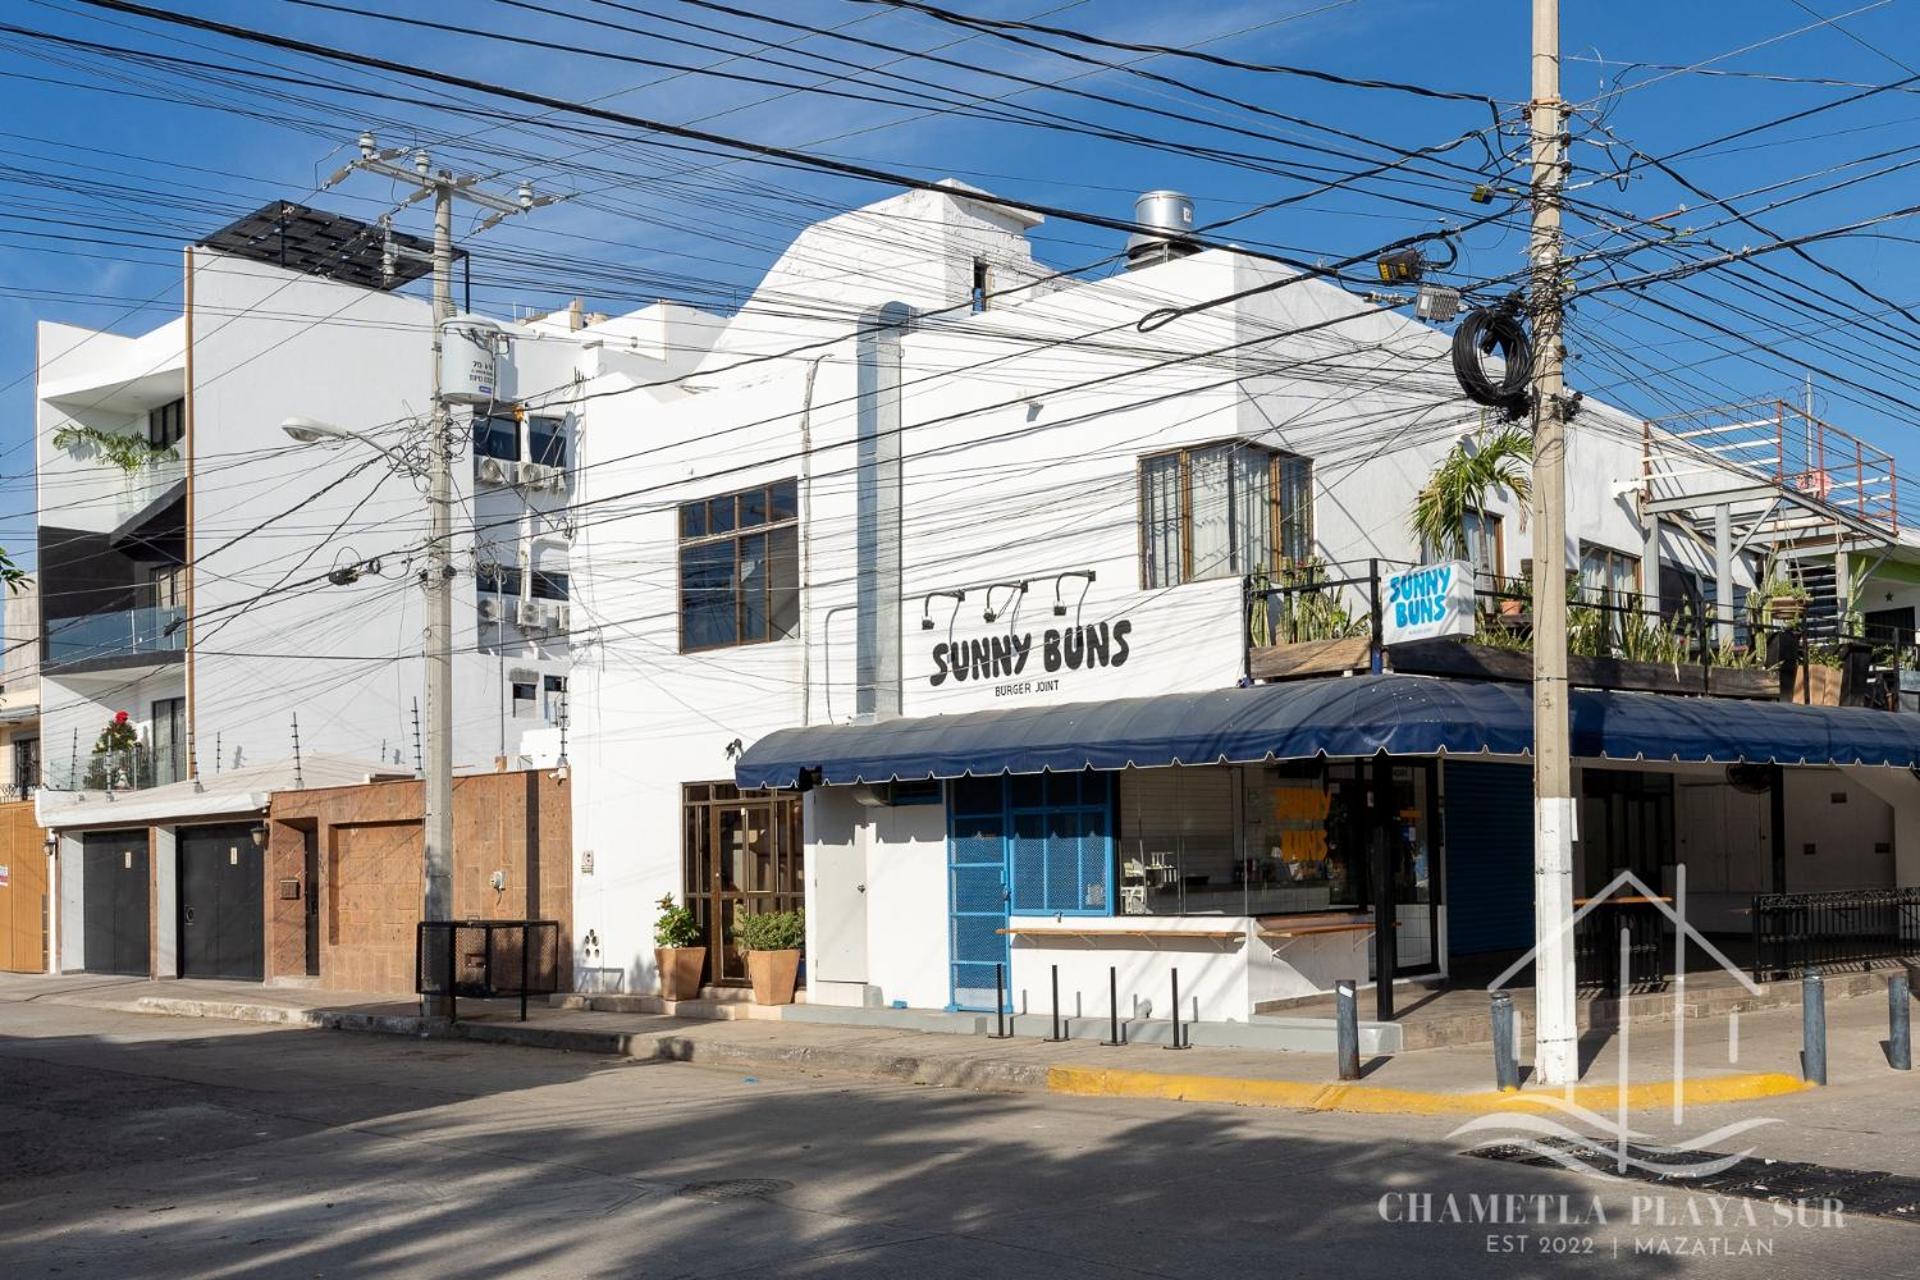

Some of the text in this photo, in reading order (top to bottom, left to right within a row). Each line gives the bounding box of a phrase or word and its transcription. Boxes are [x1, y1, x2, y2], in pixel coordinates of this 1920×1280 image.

[1390, 566, 1451, 603] SUNNY
[1396, 594, 1446, 628] BUNS
[930, 619, 1132, 687] SUNNY BUNS
[995, 680, 1059, 697] BURGER JOINT
